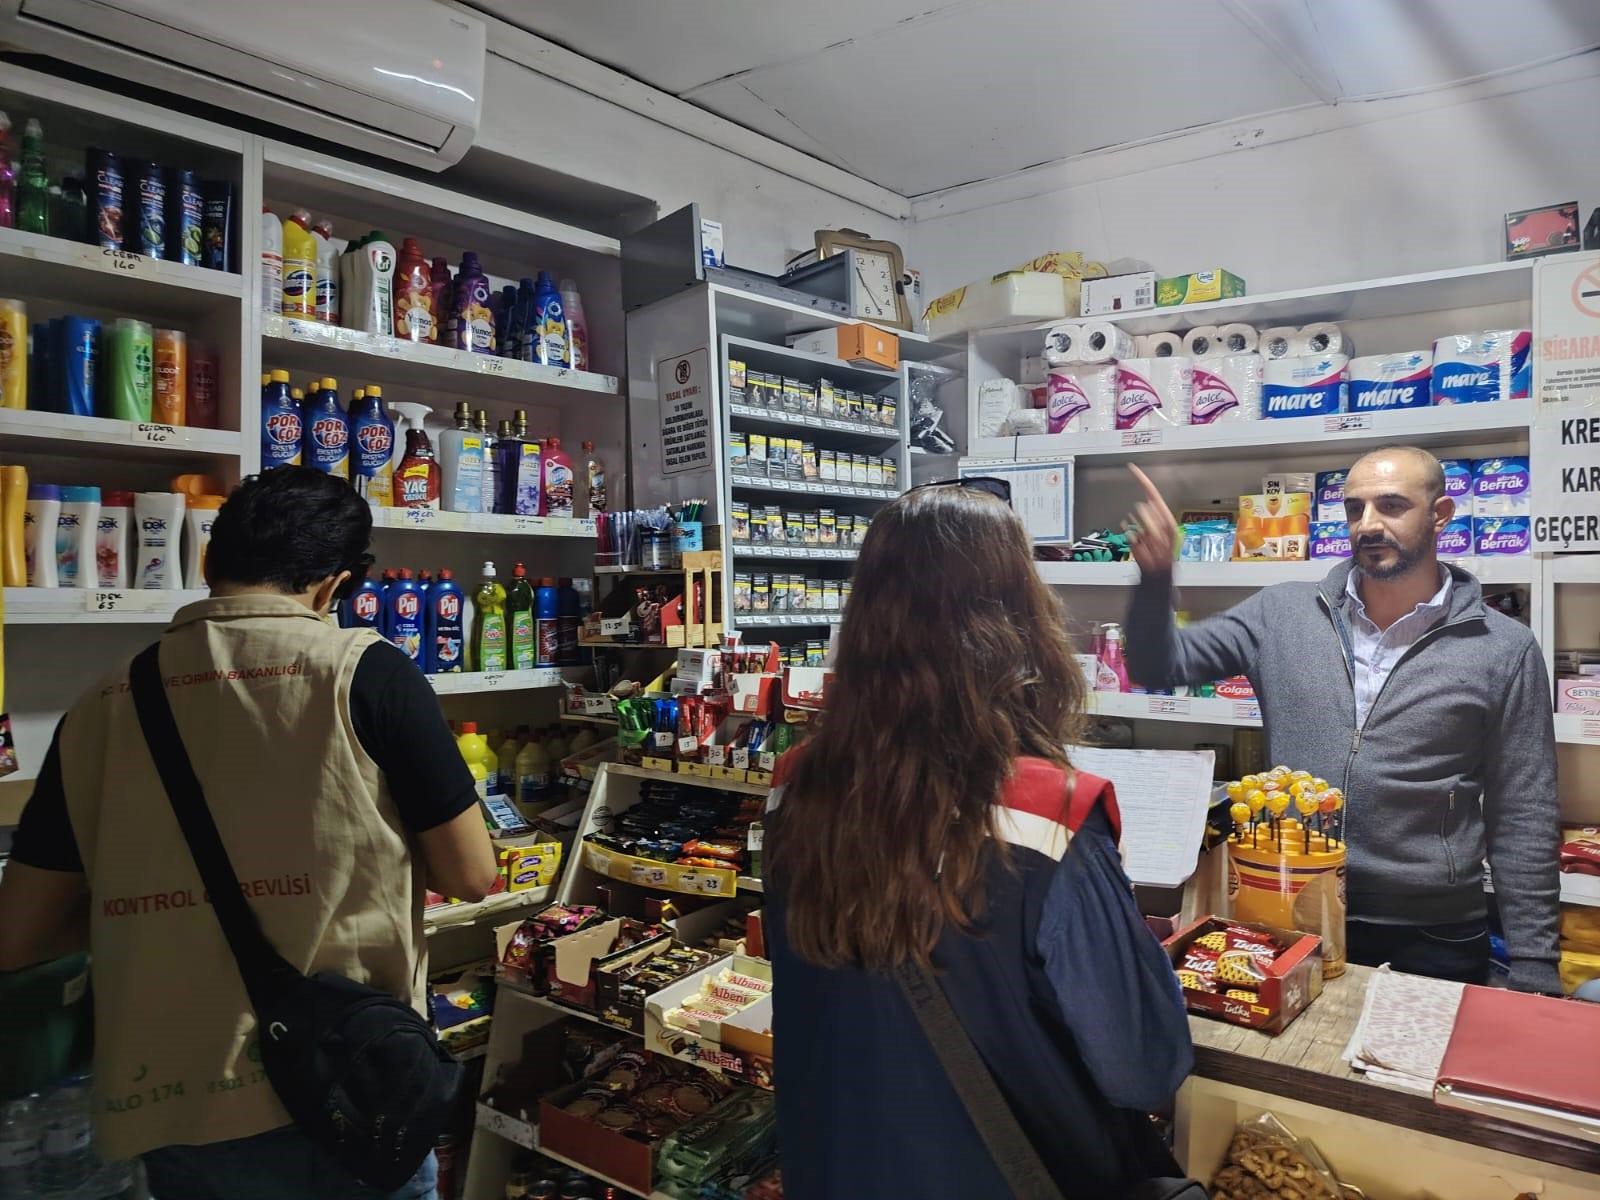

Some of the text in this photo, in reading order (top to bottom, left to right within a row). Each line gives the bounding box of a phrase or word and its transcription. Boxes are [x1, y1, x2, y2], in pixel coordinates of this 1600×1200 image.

[1442, 371, 1488, 389] mare
[1052, 394, 1074, 408] dolce
[1121, 393, 1144, 406] dolce
[1196, 392, 1221, 406] dolce
[1268, 391, 1323, 412] mare
[1357, 386, 1414, 408] mare
[267, 416, 296, 429] POR
[314, 420, 342, 433] POR
[359, 426, 386, 439] POR
[1480, 478, 1524, 491] Berrak
[142, 517, 167, 531] ipek
[1481, 537, 1525, 549] Berrak
[357, 597, 377, 614] Pril
[399, 597, 418, 614] Pril
[441, 598, 459, 614] Pril
[104, 889, 197, 917] KONTROL
[729, 975, 767, 991] Albeni
[711, 986, 747, 1003] Albeni
[698, 1048, 743, 1073] Albeni
[151, 1081, 185, 1103] 174
